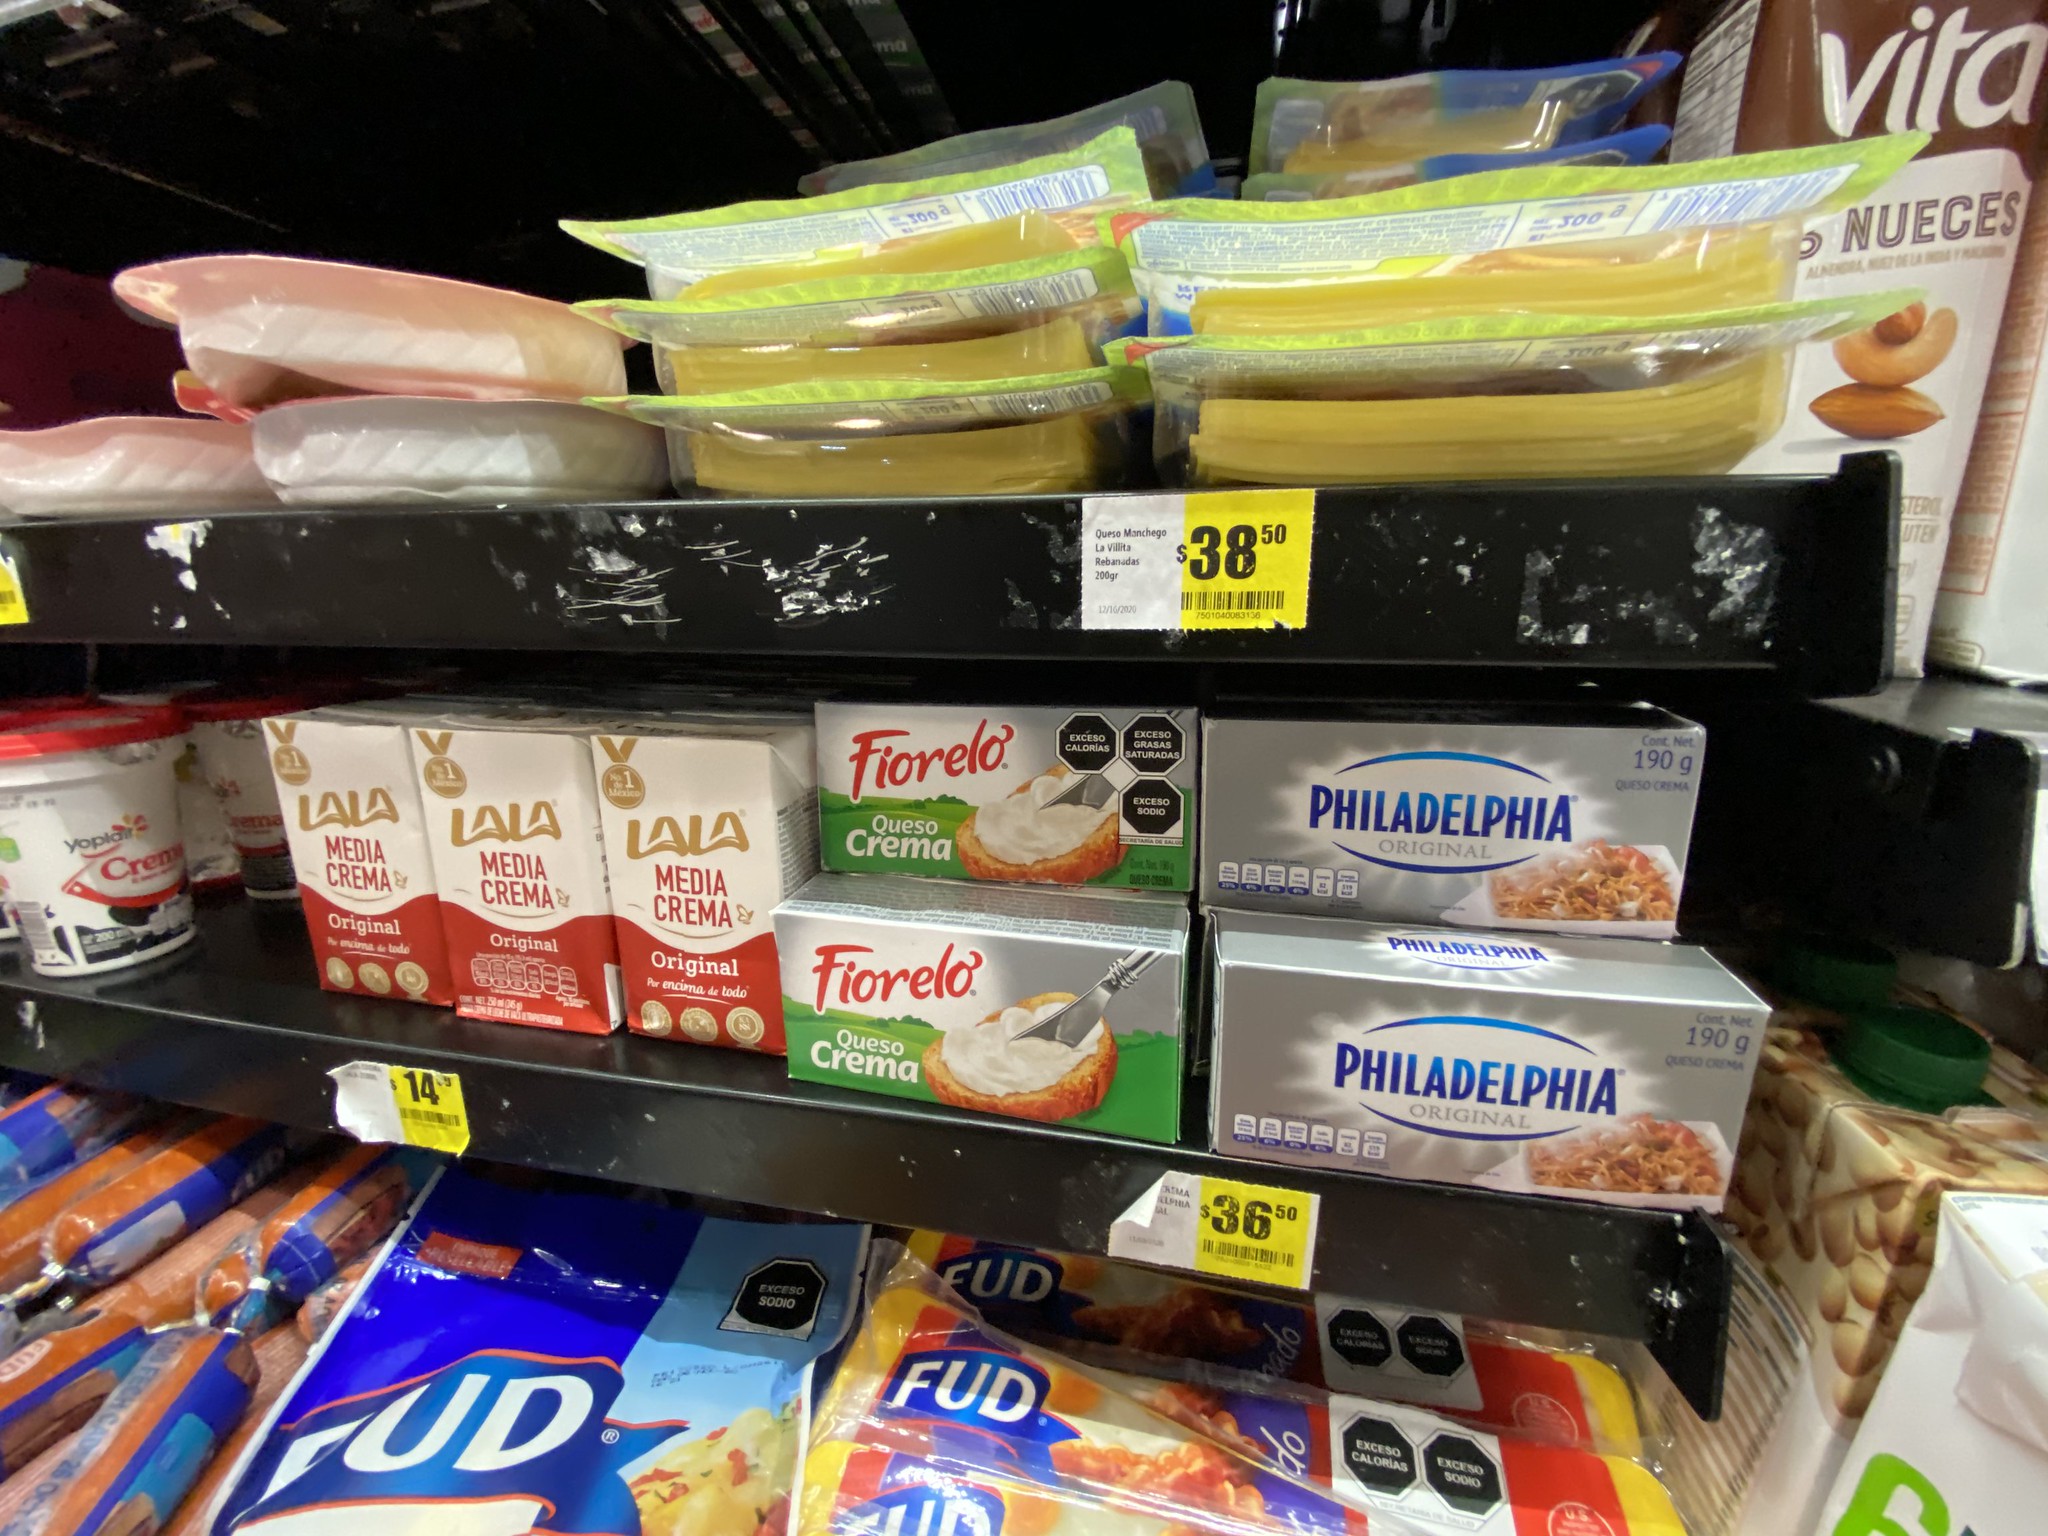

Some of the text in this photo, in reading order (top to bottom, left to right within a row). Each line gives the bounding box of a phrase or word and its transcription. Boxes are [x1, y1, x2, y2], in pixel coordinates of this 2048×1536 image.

[1820, 6, 2048, 138] vita
[1840, 191, 2021, 253] NUECES
[1095, 528, 1167, 539] Queso Manchego
[1261, 524, 1287, 544] 50
[1095, 543, 1131, 552] La Villita
[1095, 556, 1140, 566] Rebanadas
[1095, 571, 1118, 582] 200gr
[1069, 734, 1106, 743] EXCESO
[1133, 741, 1172, 749] GRASAS
[1134, 730, 1172, 739] EXCESO
[1065, 744, 1110, 753] CALORÍAS
[1125, 751, 1180, 760] SATURADAS
[1634, 749, 1693, 775] 190 g
[1615, 779, 1689, 792] QUESO CREMA
[299, 787, 400, 832] LALA
[1133, 797, 1170, 806] EXCESO
[1137, 807, 1166, 816] SODIO
[451, 800, 562, 848] LALA
[872, 813, 939, 836] Queso
[1309, 784, 1572, 843] PHILADELPHIA
[626, 811, 750, 860] LALA
[846, 828, 953, 861] Crema
[325, 835, 386, 865] MEDIA
[1378, 839, 1493, 860] ORIGINAL
[479, 850, 548, 881] MEDIA
[325, 862, 393, 892] CREMA
[655, 864, 728, 898] MEDIA
[480, 879, 555, 910] CREMA
[654, 894, 733, 929] CREMA
[328, 913, 402, 936] Original
[388, 943, 410, 955] todo
[489, 933, 559, 953] Original
[1387, 936, 1550, 962] PHILADELPHIA
[651, 951, 739, 977] Original
[1436, 955, 1509, 967] ORIGINAL
[647, 977, 747, 998] Por encima de todo
[836, 1028, 905, 1056] Queso
[1686, 1026, 1750, 1055] 190 g
[810, 1040, 919, 1084] Crema
[1665, 1055, 1744, 1071] QUESO CREMA
[1333, 1041, 1617, 1116] PHILADELPHIA
[1409, 1103, 1531, 1130] ORIGINAL
[1275, 1204, 1298, 1221] 50
[758, 1284, 805, 1295] EXCESO
[943, 1259, 1053, 1302] FUD
[758, 1296, 795, 1309] SODIO
[890, 1360, 1038, 1423] FUD
[1356, 1440, 1402, 1458] EXCESO
[1352, 1451, 1409, 1473] CALORÍAS
[1437, 1457, 1484, 1475] EXCESO
[1444, 1471, 1481, 1488] SODIO
